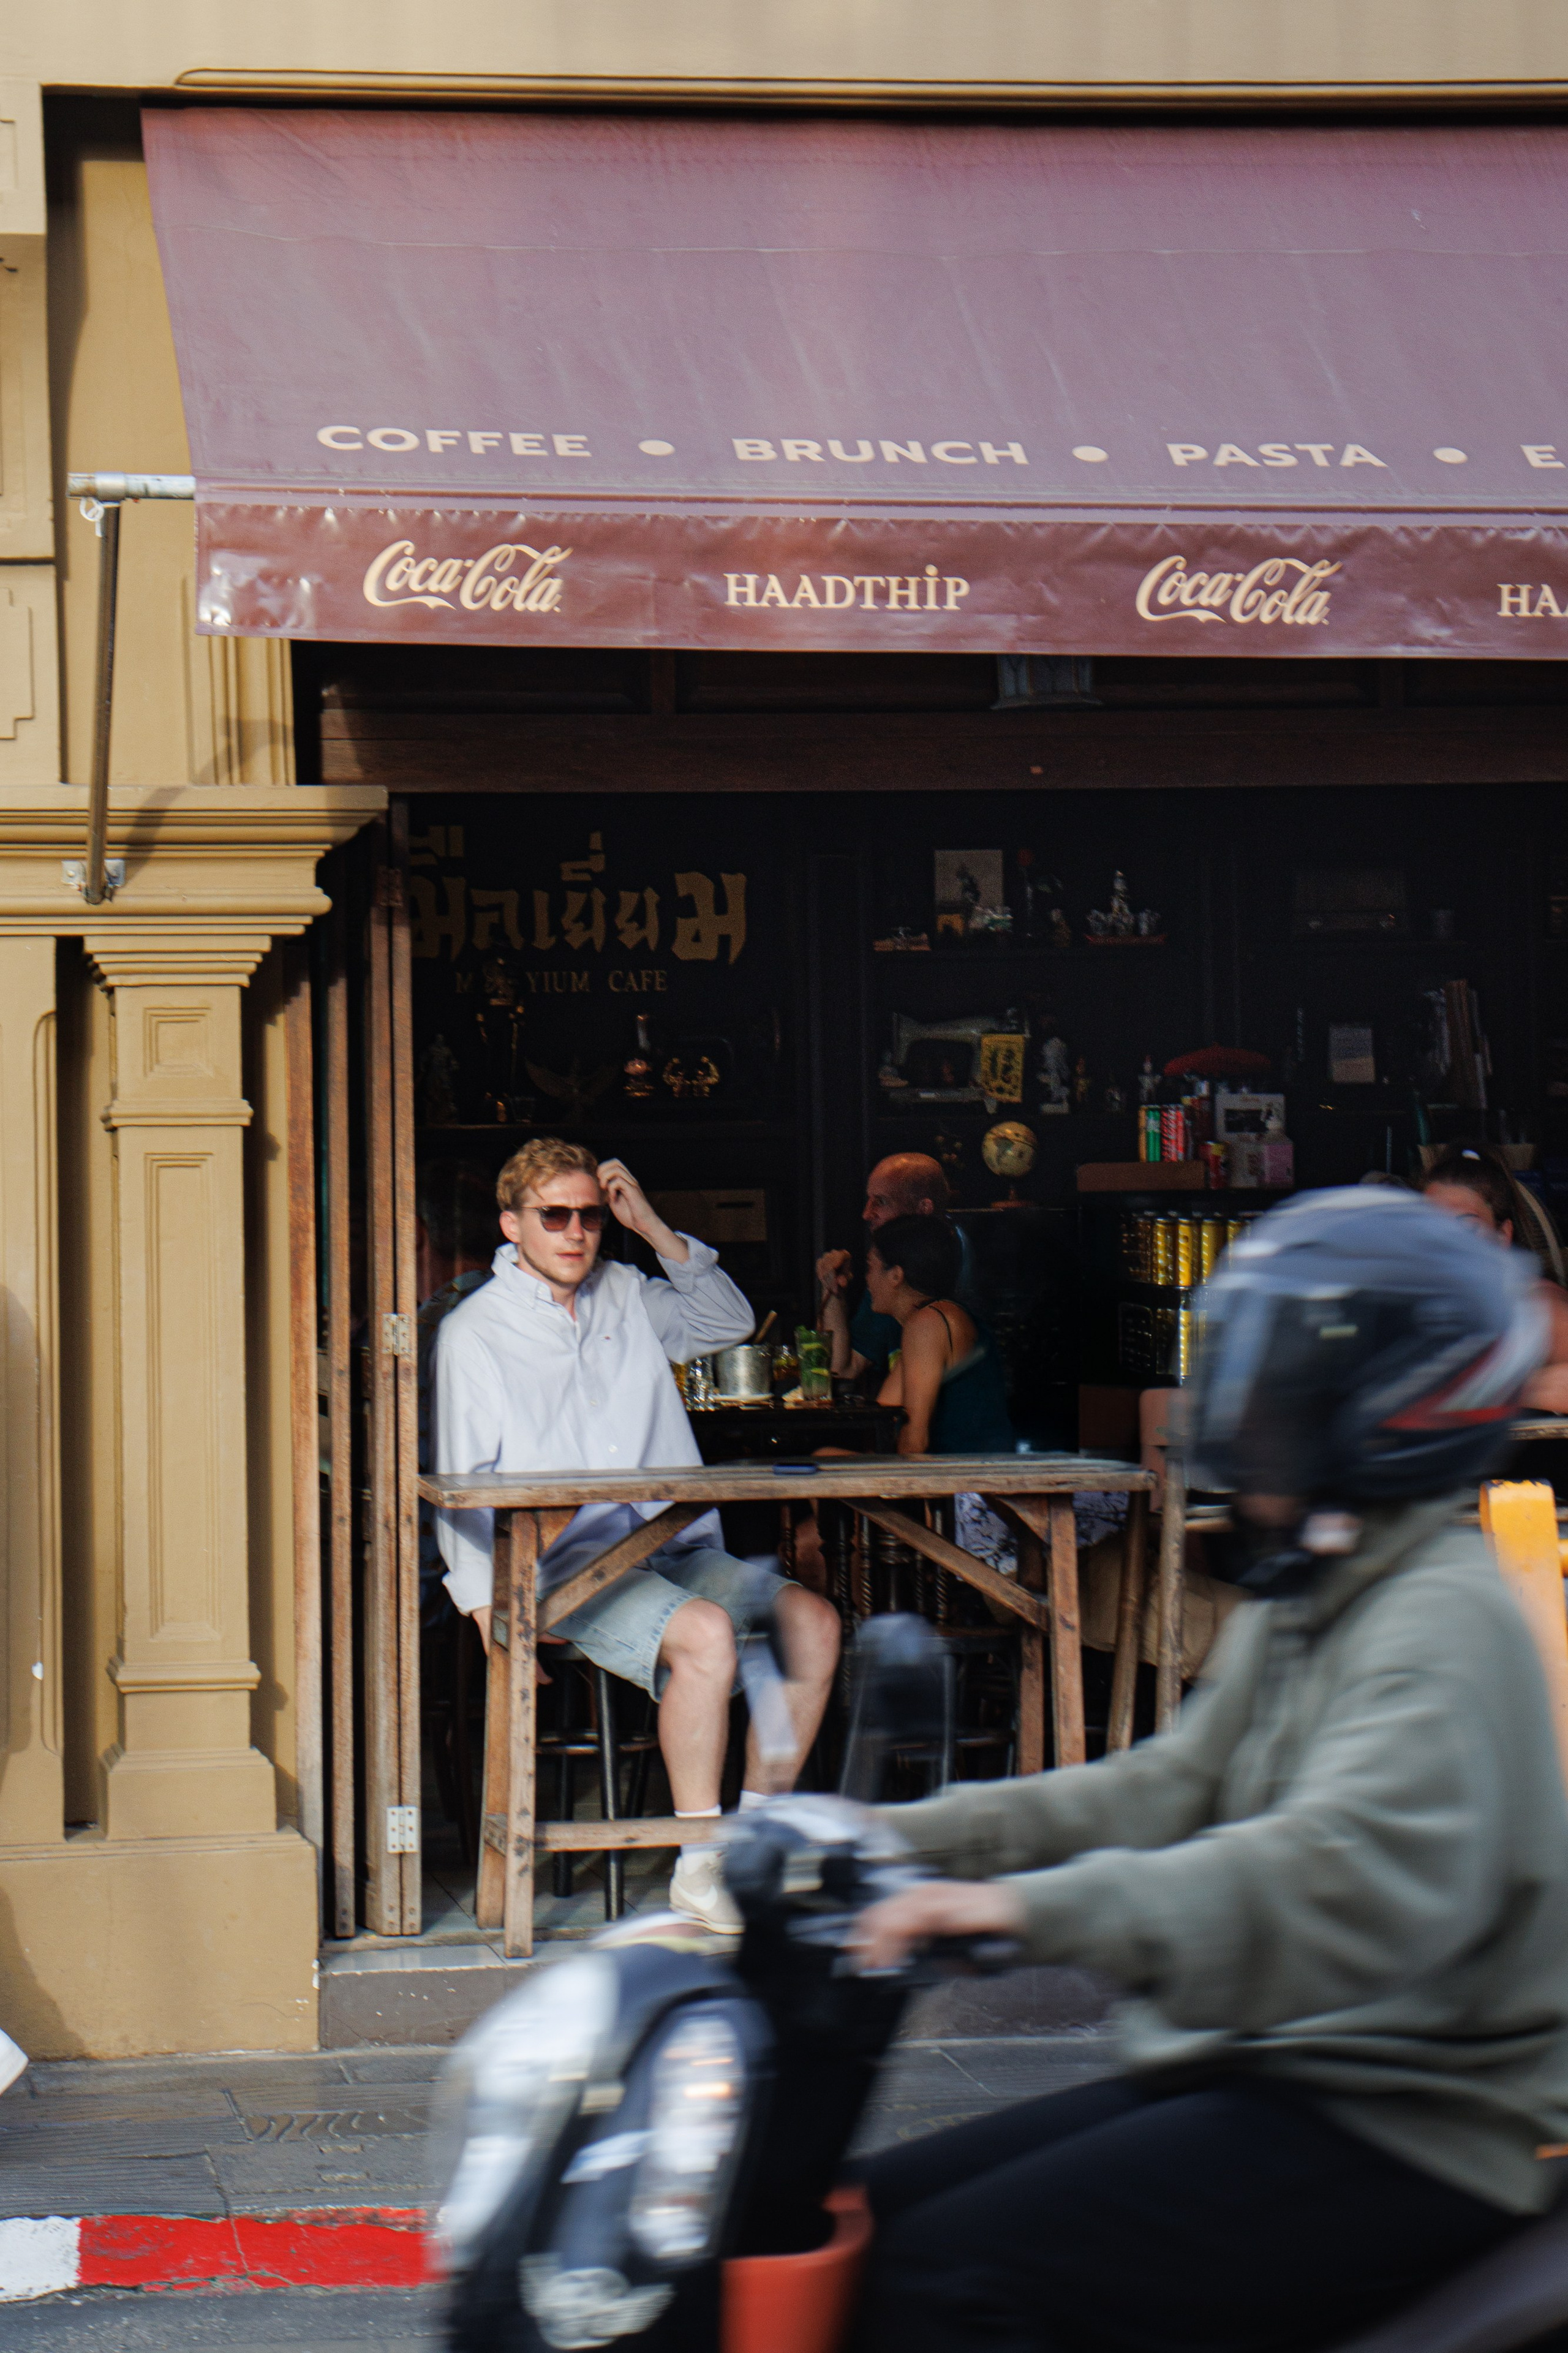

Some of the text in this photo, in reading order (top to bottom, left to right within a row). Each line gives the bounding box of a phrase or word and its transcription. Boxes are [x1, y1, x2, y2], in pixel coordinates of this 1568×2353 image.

[316, 425, 592, 457] COFFEE
[731, 438, 1030, 464] BRUNCH
[1167, 442, 1389, 468] PASTA
[363, 539, 573, 613] Coca-Cola
[1135, 554, 1343, 625] Coca-Cola
[1496, 583, 1568, 618] HA
[607, 969, 668, 993] CAFE
